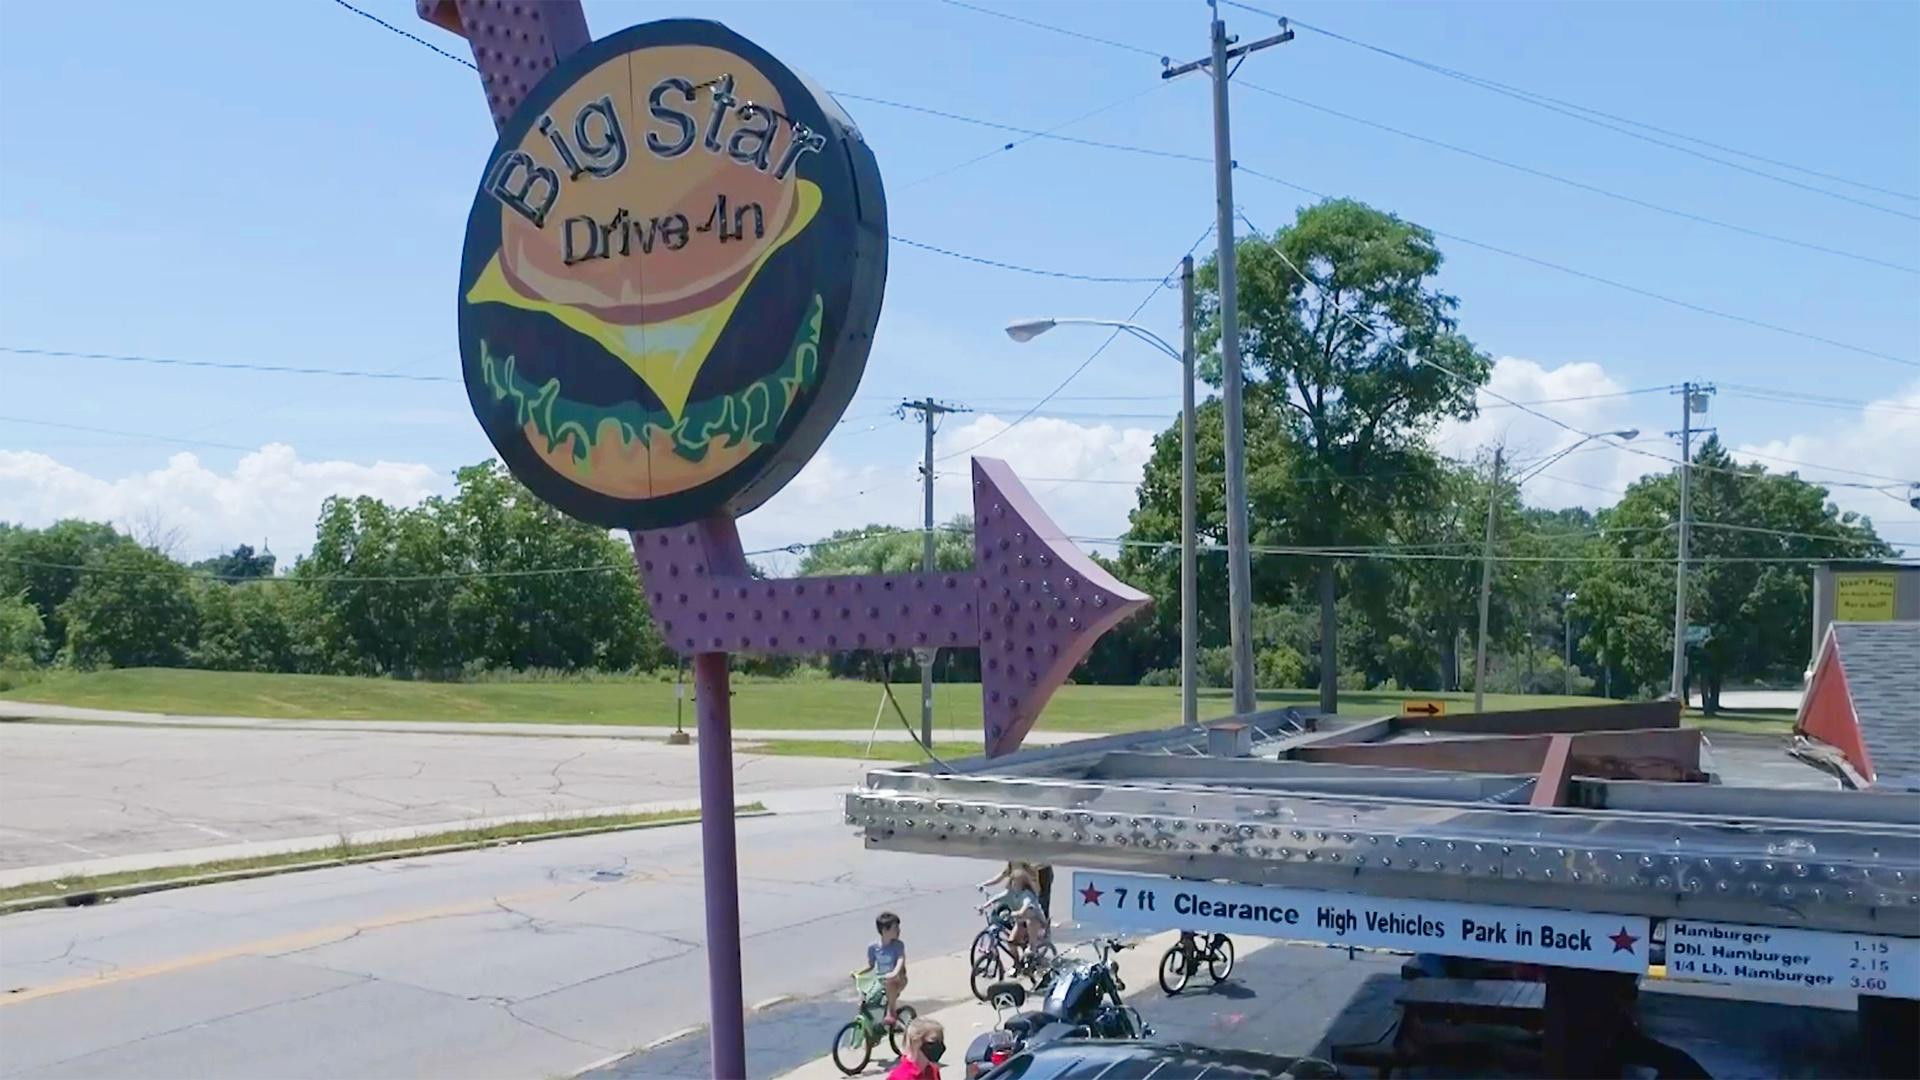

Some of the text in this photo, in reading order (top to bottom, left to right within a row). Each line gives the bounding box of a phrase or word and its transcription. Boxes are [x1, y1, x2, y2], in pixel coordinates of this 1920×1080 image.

[485, 73, 825, 229] Big Star
[1114, 888, 1593, 951] 7 ft Clearance High Vehicles Park in Back
[1674, 924, 1889, 954] Hamburger 1.15
[1673, 942, 1889, 973] Dbl. Hamburger 2.15
[1674, 960, 1887, 991] 1/4 Lb. Hamburger 3.60
